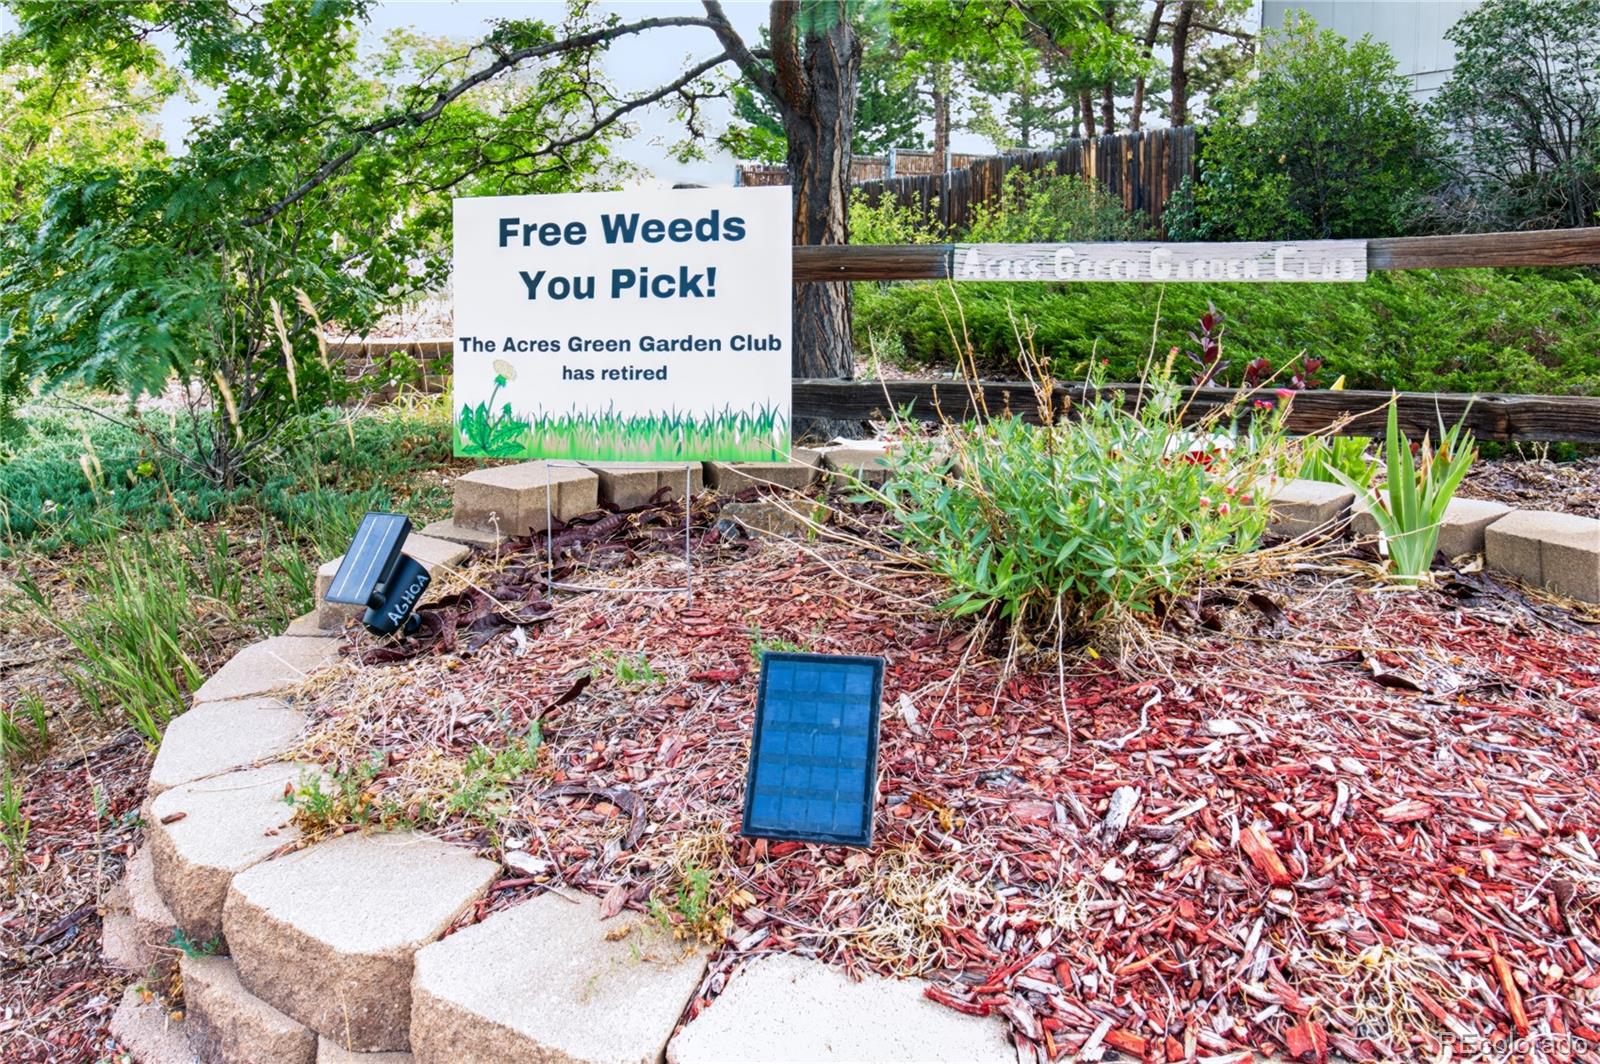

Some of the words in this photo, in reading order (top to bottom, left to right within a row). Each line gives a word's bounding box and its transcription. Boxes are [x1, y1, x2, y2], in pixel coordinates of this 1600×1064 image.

[499, 217, 587, 248] Free
[600, 209, 746, 245] Weeds
[519, 270, 596, 300] You
[611, 265, 717, 299] Pick!
[459, 336, 496, 353] The
[502, 336, 561, 353] Acres
[567, 335, 632, 352] Green
[639, 334, 722, 352] Garden
[729, 334, 782, 352] Club
[562, 365, 595, 381] has
[601, 365, 668, 381] retired
[387, 574, 429, 626] AGHOA
